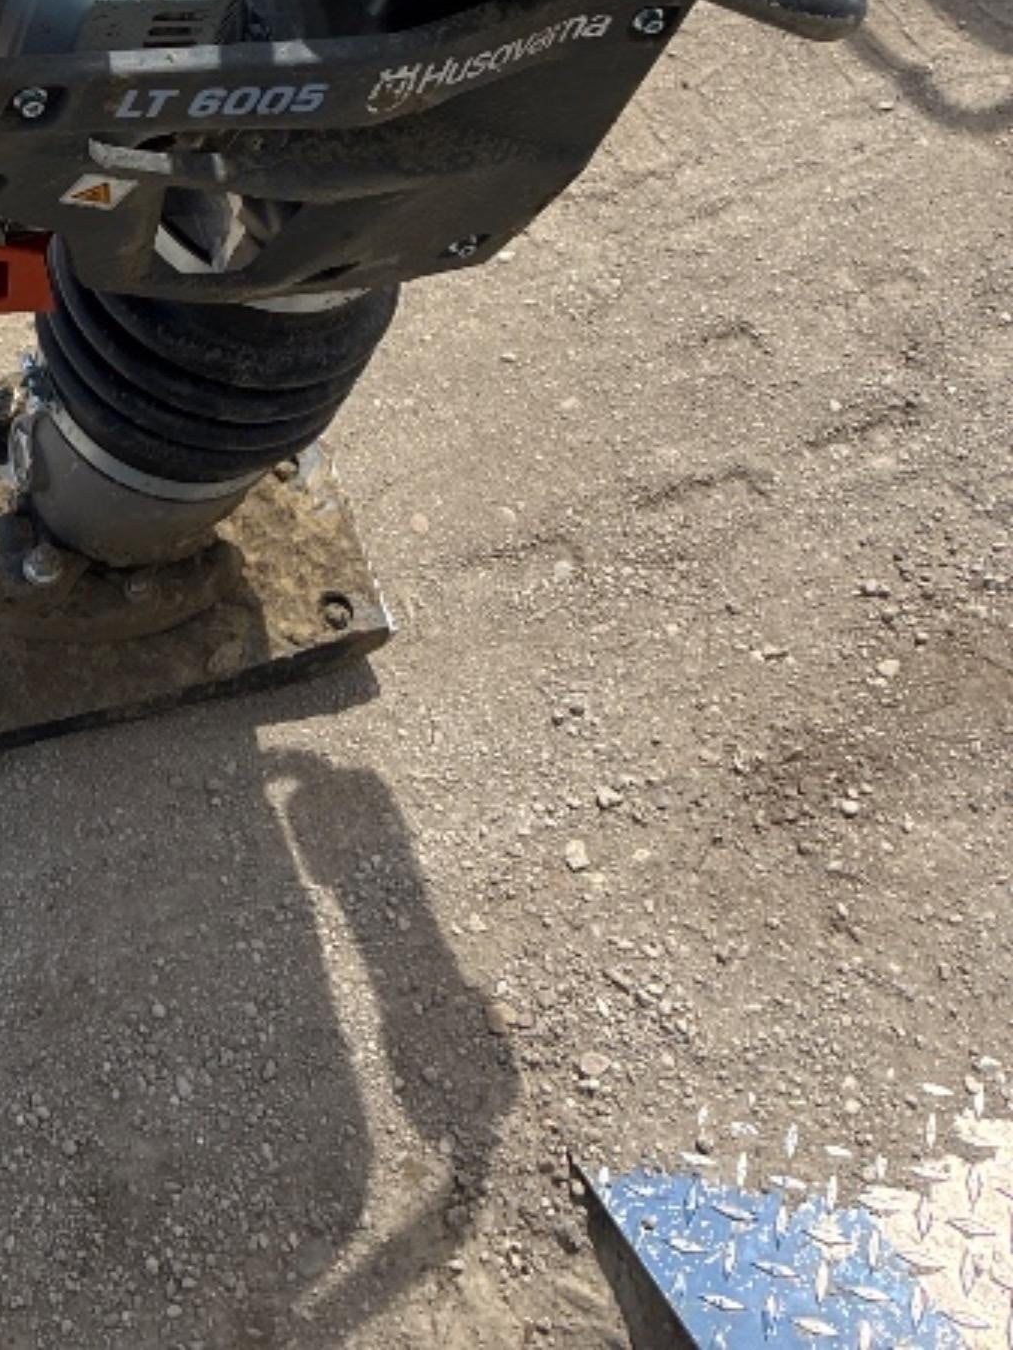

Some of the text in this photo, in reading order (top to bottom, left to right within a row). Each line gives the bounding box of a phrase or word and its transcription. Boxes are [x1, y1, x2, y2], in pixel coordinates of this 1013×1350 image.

[415, 15, 612, 95] Husqvarna
[115, 84, 329, 118] LT 6005
